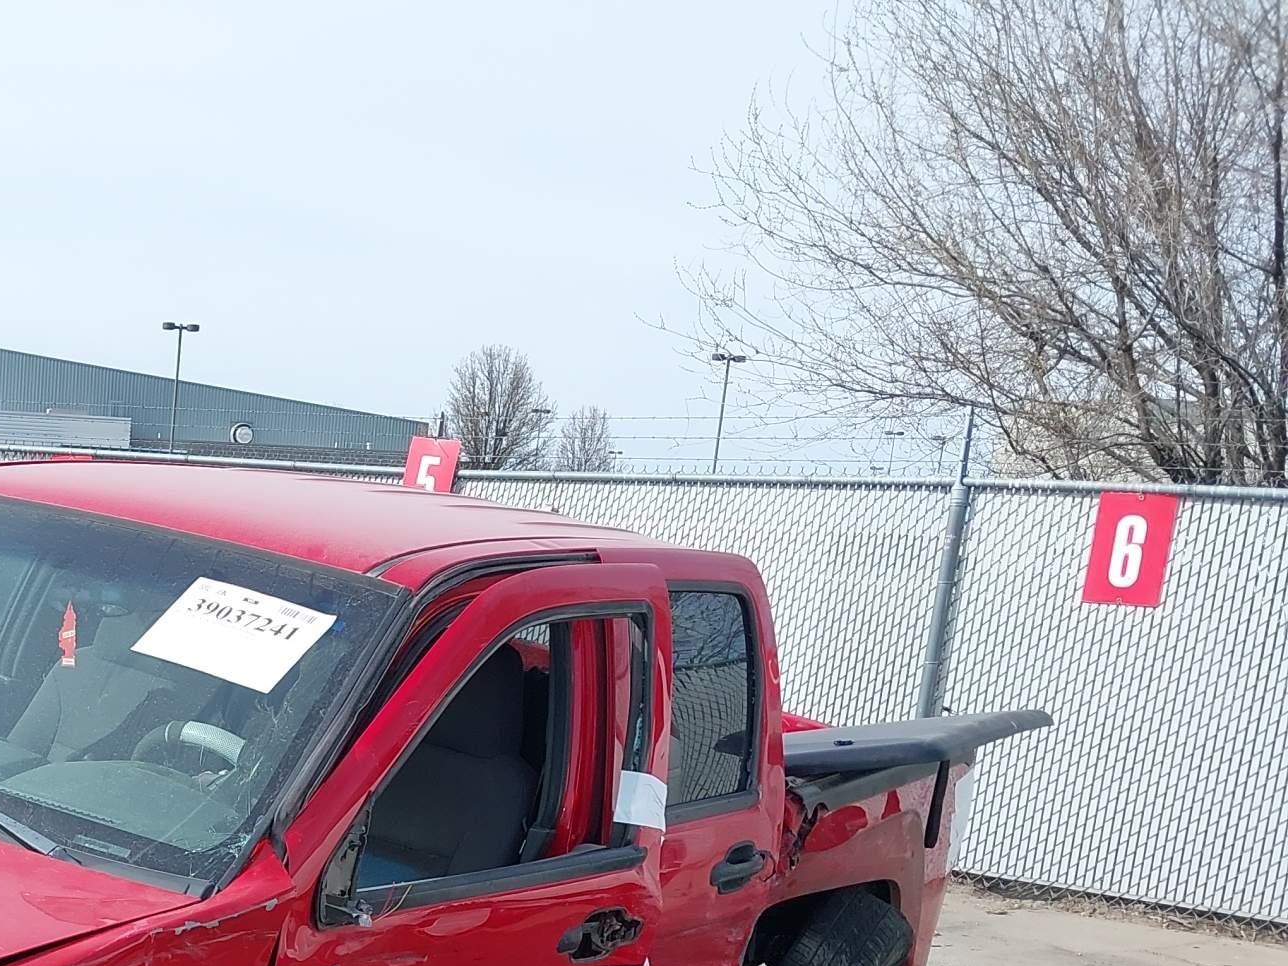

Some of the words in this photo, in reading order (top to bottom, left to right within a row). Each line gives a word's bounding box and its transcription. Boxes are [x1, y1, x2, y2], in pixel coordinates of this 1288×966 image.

[415, 455, 441, 491] 5
[1108, 514, 1148, 588] 6
[187, 598, 300, 640] 39037241
